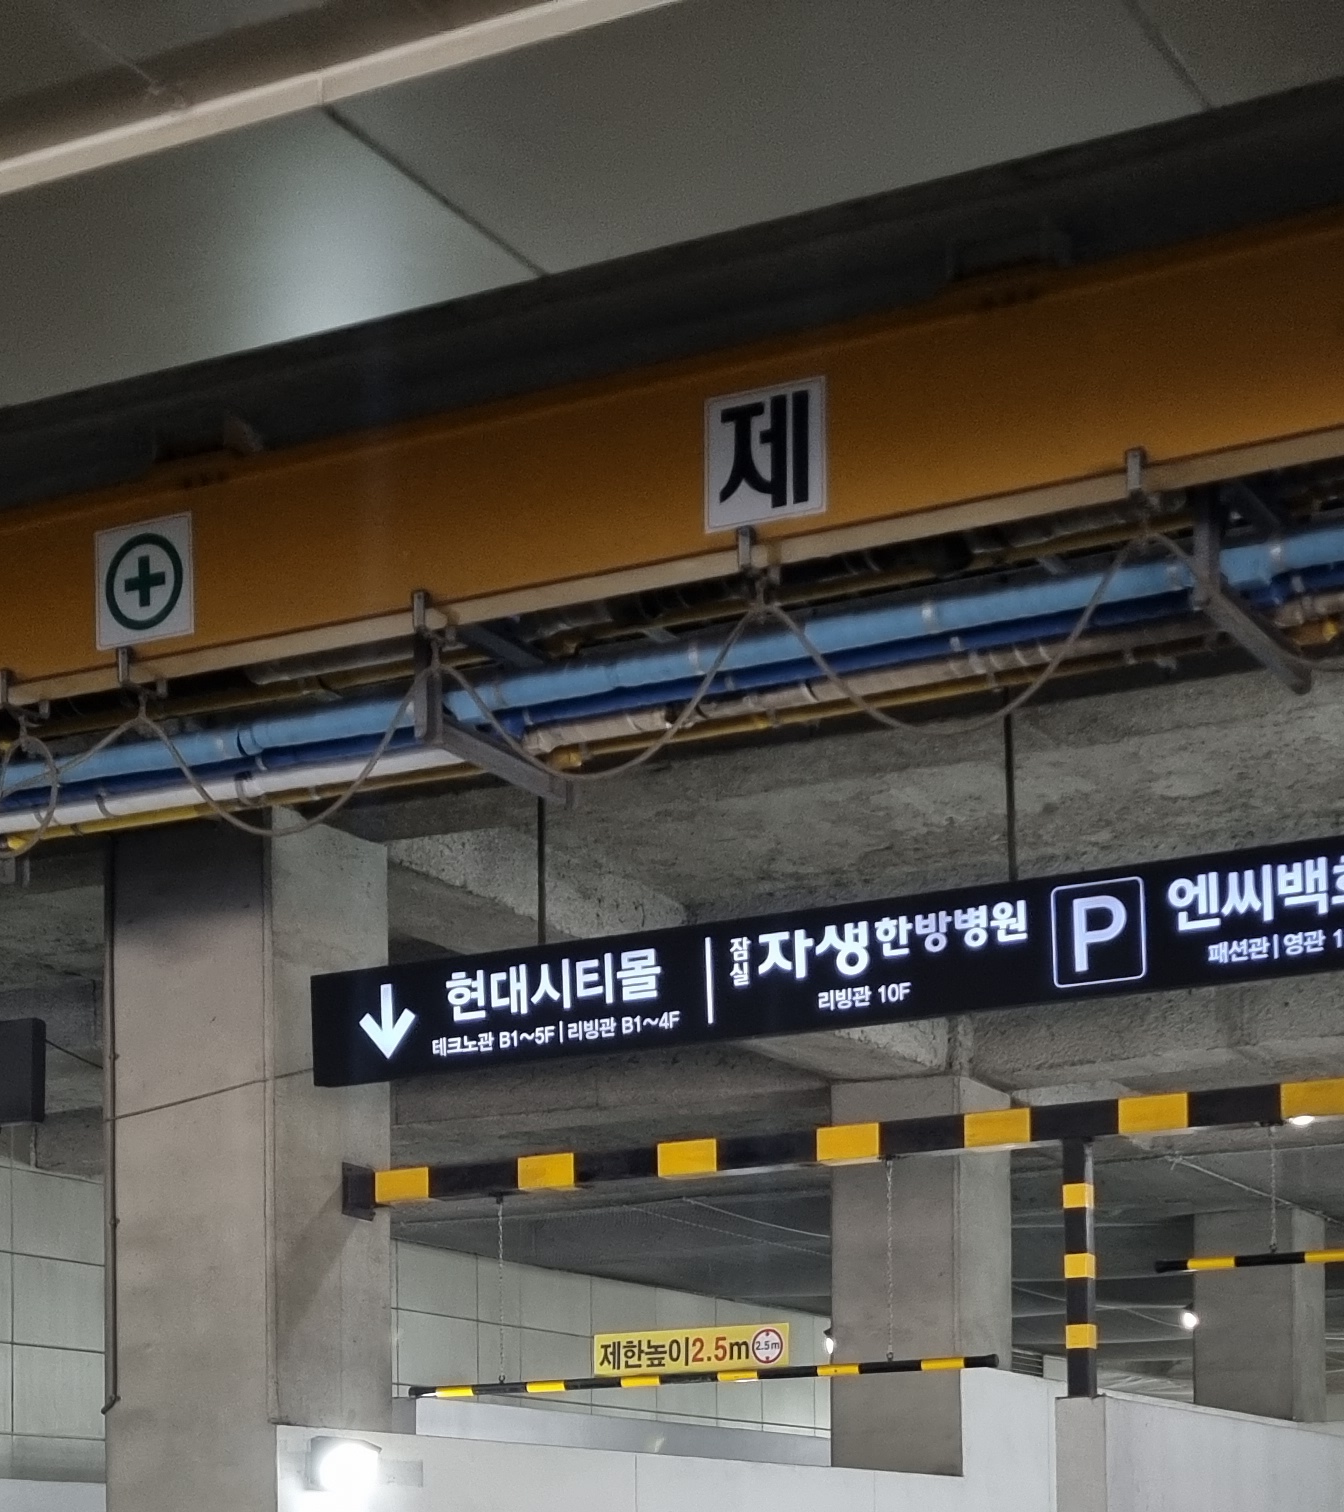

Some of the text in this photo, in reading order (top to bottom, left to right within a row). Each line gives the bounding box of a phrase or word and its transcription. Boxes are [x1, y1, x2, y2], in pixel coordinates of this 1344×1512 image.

[1071, 893, 1128, 974] P
[1283, 930, 1326, 956] 영관
[1207, 937, 1269, 964] 패션관
[445, 947, 662, 1022] 현대시티몰
[818, 982, 912, 1012] 리빙관 10F
[567, 1019, 617, 1042] 리빙관
[432, 1031, 494, 1058] 테크노관
[755, 1339, 780, 1352] 2.5m
